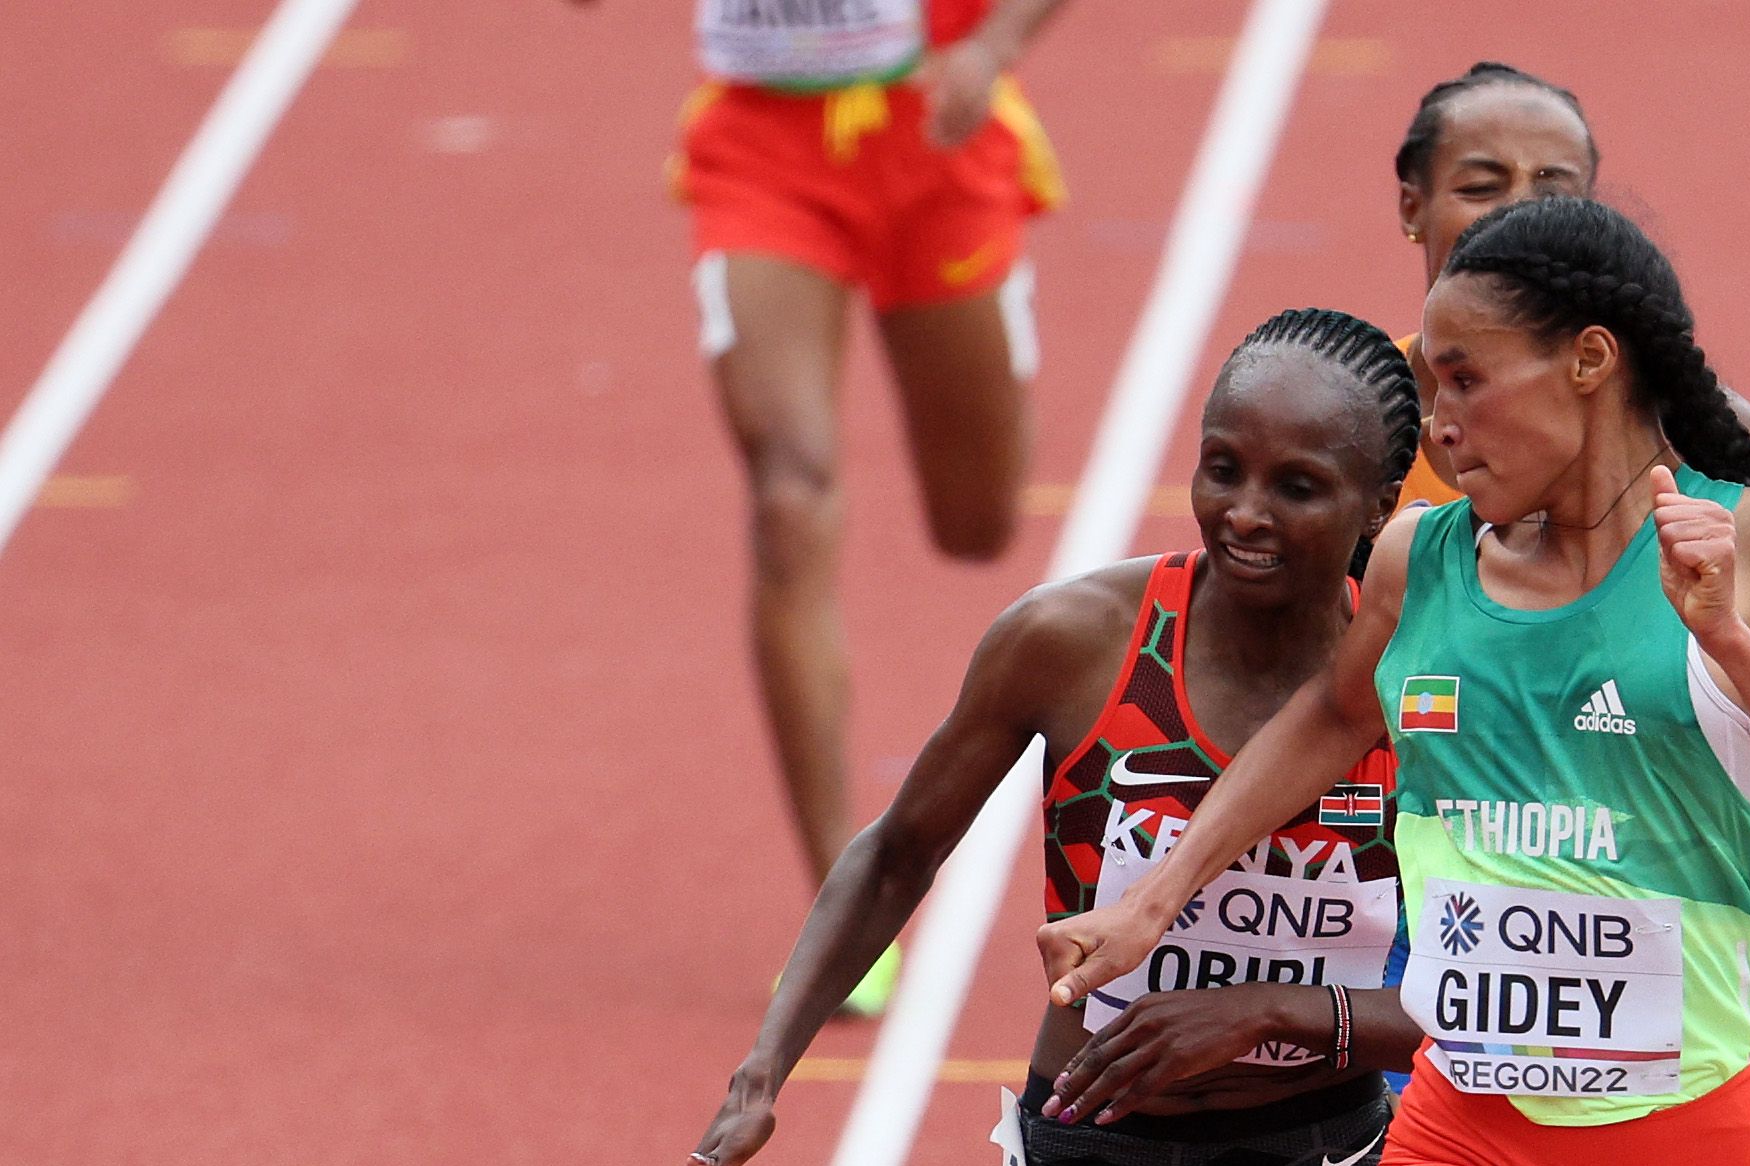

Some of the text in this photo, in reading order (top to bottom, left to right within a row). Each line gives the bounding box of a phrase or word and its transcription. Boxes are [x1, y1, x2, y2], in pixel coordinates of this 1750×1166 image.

[1574, 711, 1637, 735] adidas
[1218, 888, 1354, 938] QNB
[1498, 905, 1634, 958] QNB
[1435, 968, 1628, 1039] GIDEY
[1449, 1059, 1629, 1093] REGON22
